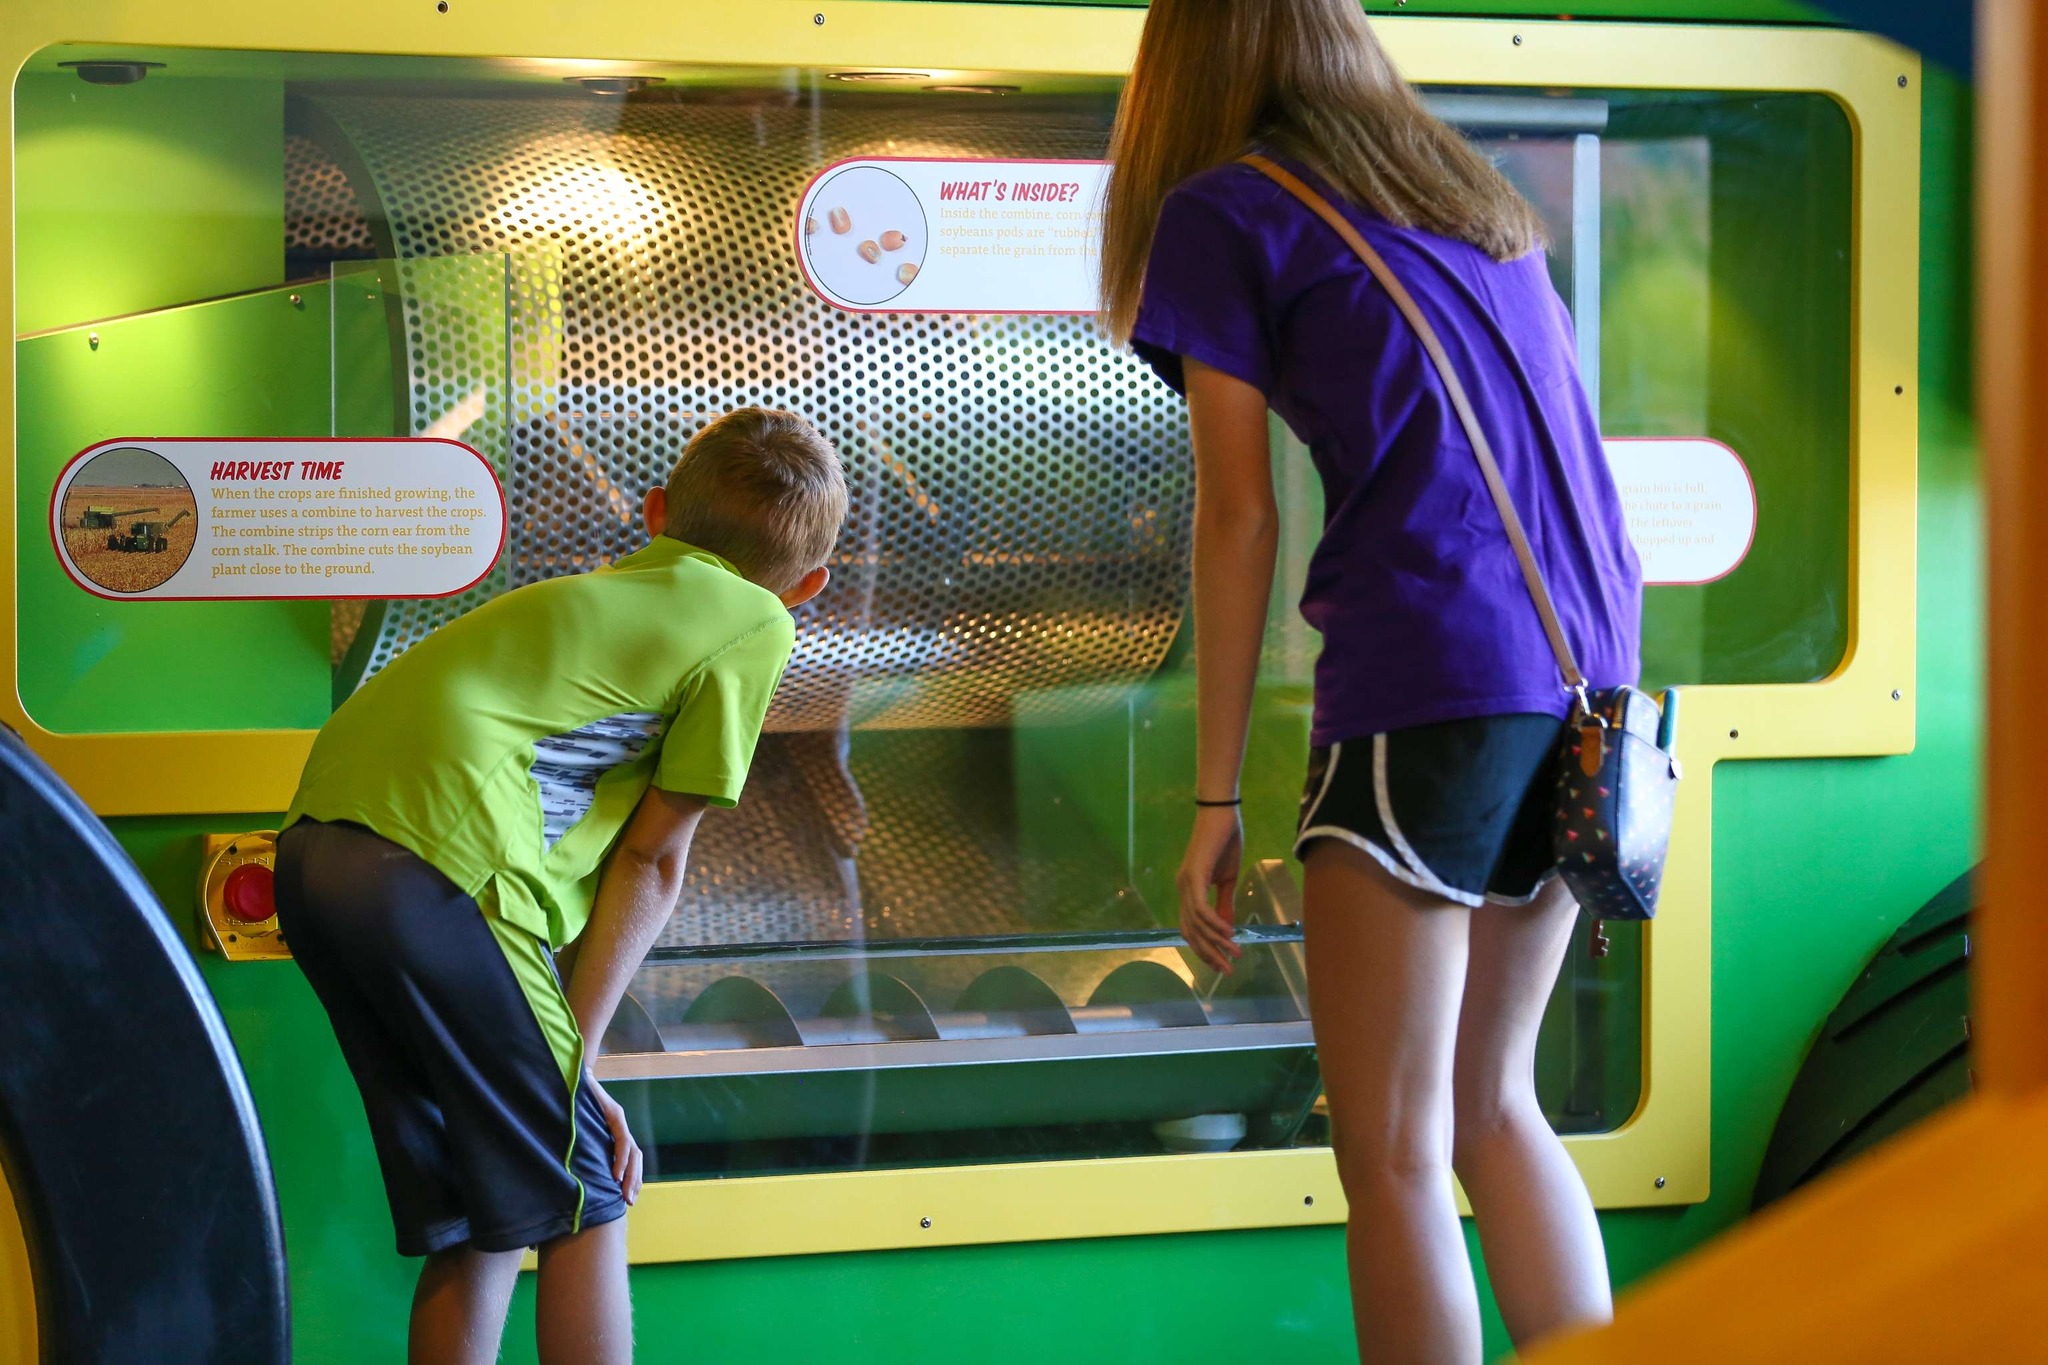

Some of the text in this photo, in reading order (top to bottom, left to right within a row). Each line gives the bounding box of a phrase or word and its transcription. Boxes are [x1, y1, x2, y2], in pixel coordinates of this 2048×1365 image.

[940, 179, 1080, 203] WHAT'S INSIDE?
[940, 208, 976, 219] Inside
[979, 208, 998, 219] the
[1001, 208, 1053, 221] combine,
[1056, 211, 1081, 220] corn
[940, 226, 993, 240] soybeans
[997, 226, 1024, 239] pods
[1026, 229, 1045, 238] are
[940, 245, 1099, 258] separate the grain from the
[210, 460, 345, 482] HARVEST TIME
[210, 486, 476, 504] When the crops are finished growing, the
[210, 505, 486, 521] farmer uses a combine to harvest the crops.
[210, 524, 470, 541] The combine strips the corn ear from the
[210, 542, 473, 559] corn stalk. The combine cuts the soybean
[210, 562, 375, 579] plant close to the ground.
